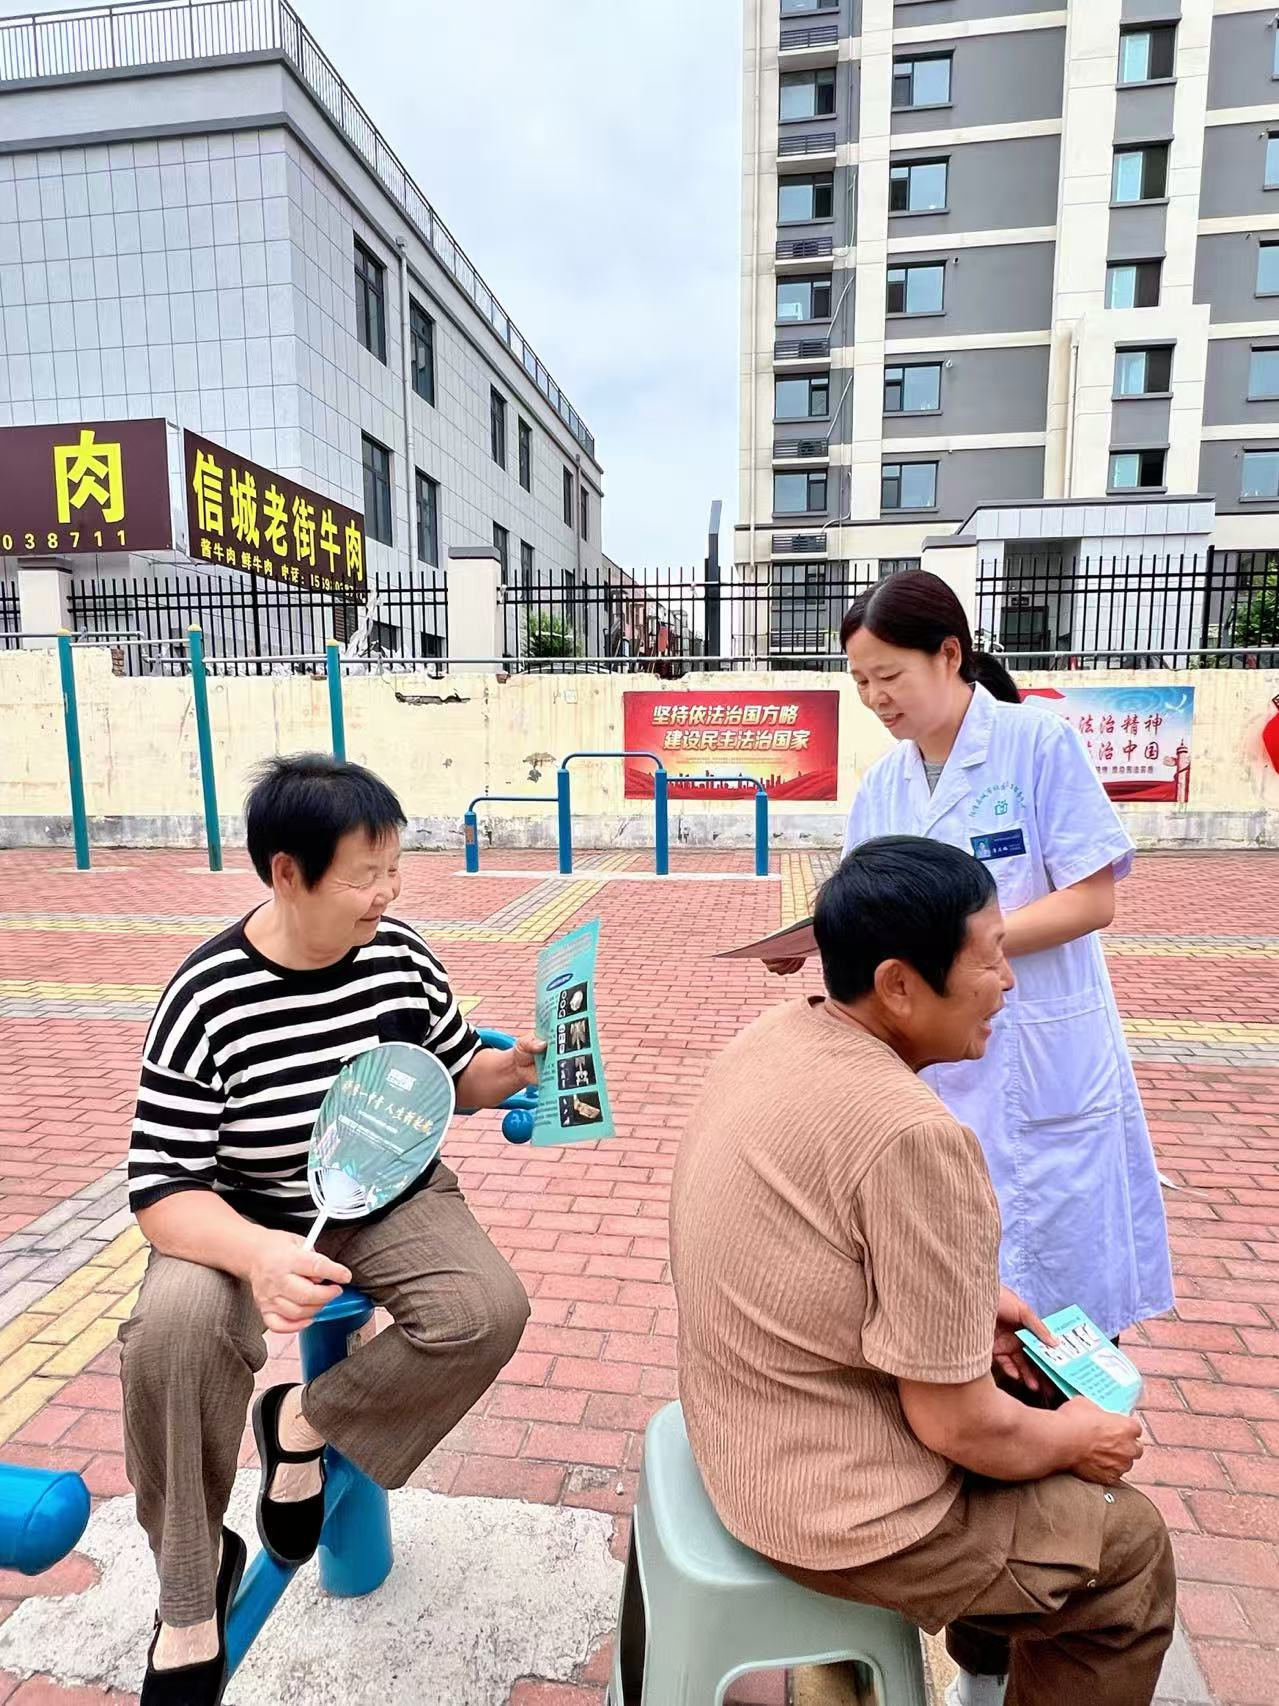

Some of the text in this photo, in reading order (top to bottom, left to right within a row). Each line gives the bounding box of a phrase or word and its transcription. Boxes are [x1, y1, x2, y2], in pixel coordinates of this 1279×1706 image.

[53, 429, 125, 524] 肉
[193, 448, 364, 582] 信城老街牛肉
[200, 538, 236, 565] 酱牛肉
[241, 551, 273, 576] 鲜牛肉
[652, 704, 799, 726] 坚持依法治国方略
[1065, 713, 1163, 736] 法治精神
[663, 729, 811, 751] 建设民主法治国家
